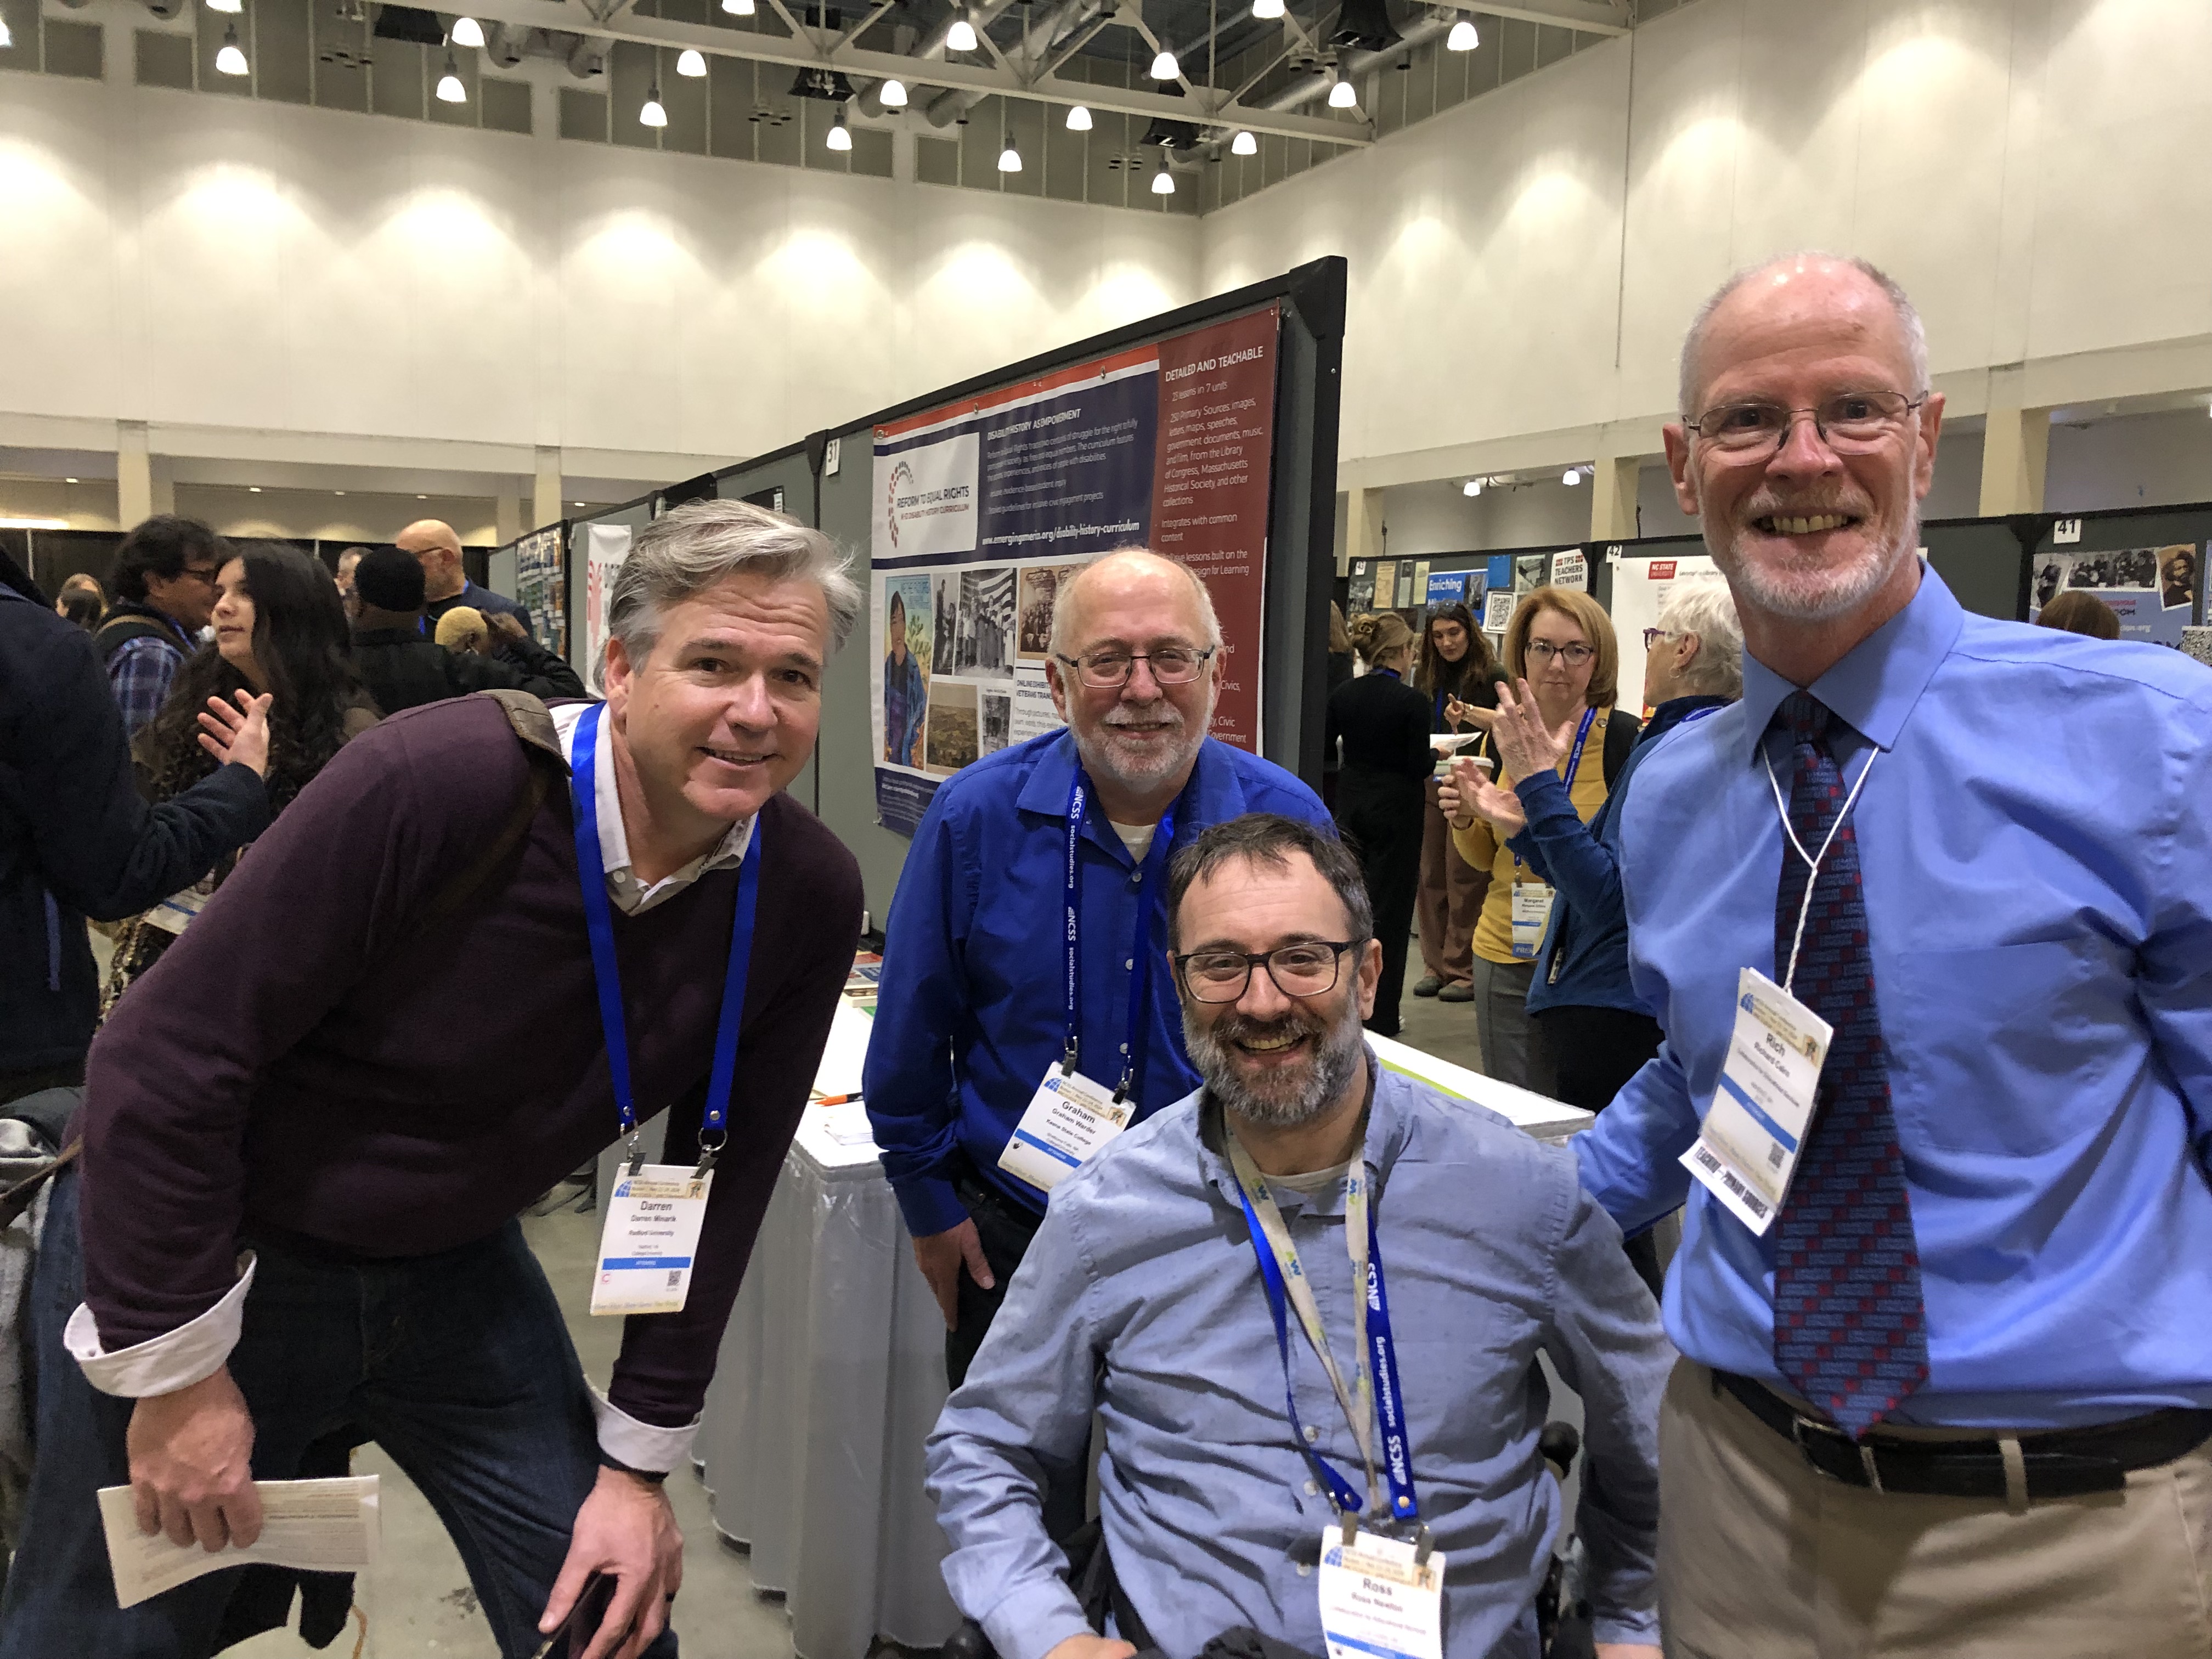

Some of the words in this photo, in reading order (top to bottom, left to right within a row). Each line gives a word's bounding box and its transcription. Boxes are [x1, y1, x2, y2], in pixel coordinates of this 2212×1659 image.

[1165, 364, 1196, 382] DETAILED
[1197, 359, 1216, 373] AND
[1218, 346, 1263, 368] TEACHABLE
[1197, 385, 1205, 395] in
[1206, 383, 1211, 393] 7
[1212, 380, 1228, 392] units
[1180, 408, 1203, 419] Primary
[1232, 398, 1256, 410] images,
[1009, 421, 1031, 433] HISTORY
[1032, 420, 1041, 430] AS
[1071, 429, 1093, 440] struggle
[1102, 426, 1110, 434] the
[1186, 423, 1206, 433] maps,
[1077, 442, 1087, 450] The
[1087, 438, 1116, 450] curriculum
[1167, 436, 1202, 453] government
[1203, 430, 1242, 445] documents,
[1242, 426, 1263, 438] music,
[828, 440, 838, 464] 31
[1166, 456, 1176, 465] and
[1190, 450, 1208, 461] from
[1209, 448, 1220, 458] the
[1220, 445, 1243, 456] Library
[1165, 470, 1172, 479] of
[1172, 466, 1199, 478] Congress,
[1201, 459, 1248, 475] Massachusetts
[1164, 481, 1189, 493] Historical
[1190, 477, 1215, 490] Society,
[1217, 475, 1228, 486] and
[1229, 474, 1248, 484] other
[897, 495, 919, 508] REFORM
[944, 486, 969, 500] RIGHTS
[1084, 492, 1104, 503] projects
[1163, 496, 1194, 507] collections
[1161, 517, 1191, 529] Integrates
[1192, 515, 1207, 525] with
[1209, 514, 1238, 524] common
[2057, 520, 2077, 534] 41
[1161, 532, 1183, 542] content
[1186, 551, 1211, 562] lessons
[1211, 549, 1224, 560] built
[1226, 550, 1235, 560] on
[1237, 549, 1248, 558] the
[1609, 545, 1620, 556] 42
[1564, 556, 1575, 565] TPS
[1211, 565, 1220, 575] for
[1220, 564, 1249, 576] Learning
[1555, 564, 1583, 577] TEACHERS
[1429, 578, 1463, 592] Enriching
[1555, 574, 1583, 585] NETWORK
[1224, 644, 1234, 654] nd
[1221, 680, 1241, 692] Civics,
[1218, 716, 1235, 727] Civic
[1071, 793, 1083, 820] NCSS
[1068, 915, 1076, 941] NCSS
[1766, 1032, 1786, 1057] Rich
[1062, 1101, 1096, 1124] Graham
[1052, 1108, 1075, 1124] Graham
[1075, 1119, 1097, 1135] Warder
[1061, 1125, 1073, 1136] State
[1073, 1131, 1092, 1146] College
[640, 1200, 674, 1211] Darren
[631, 1214, 652, 1222] Darren
[1368, 1262, 1379, 1301] NCSS
[1375, 1336, 1397, 1427] socialstudies.org
[1387, 1434, 1405, 1475] NCSS
[1363, 1577, 1393, 1596] Ross
